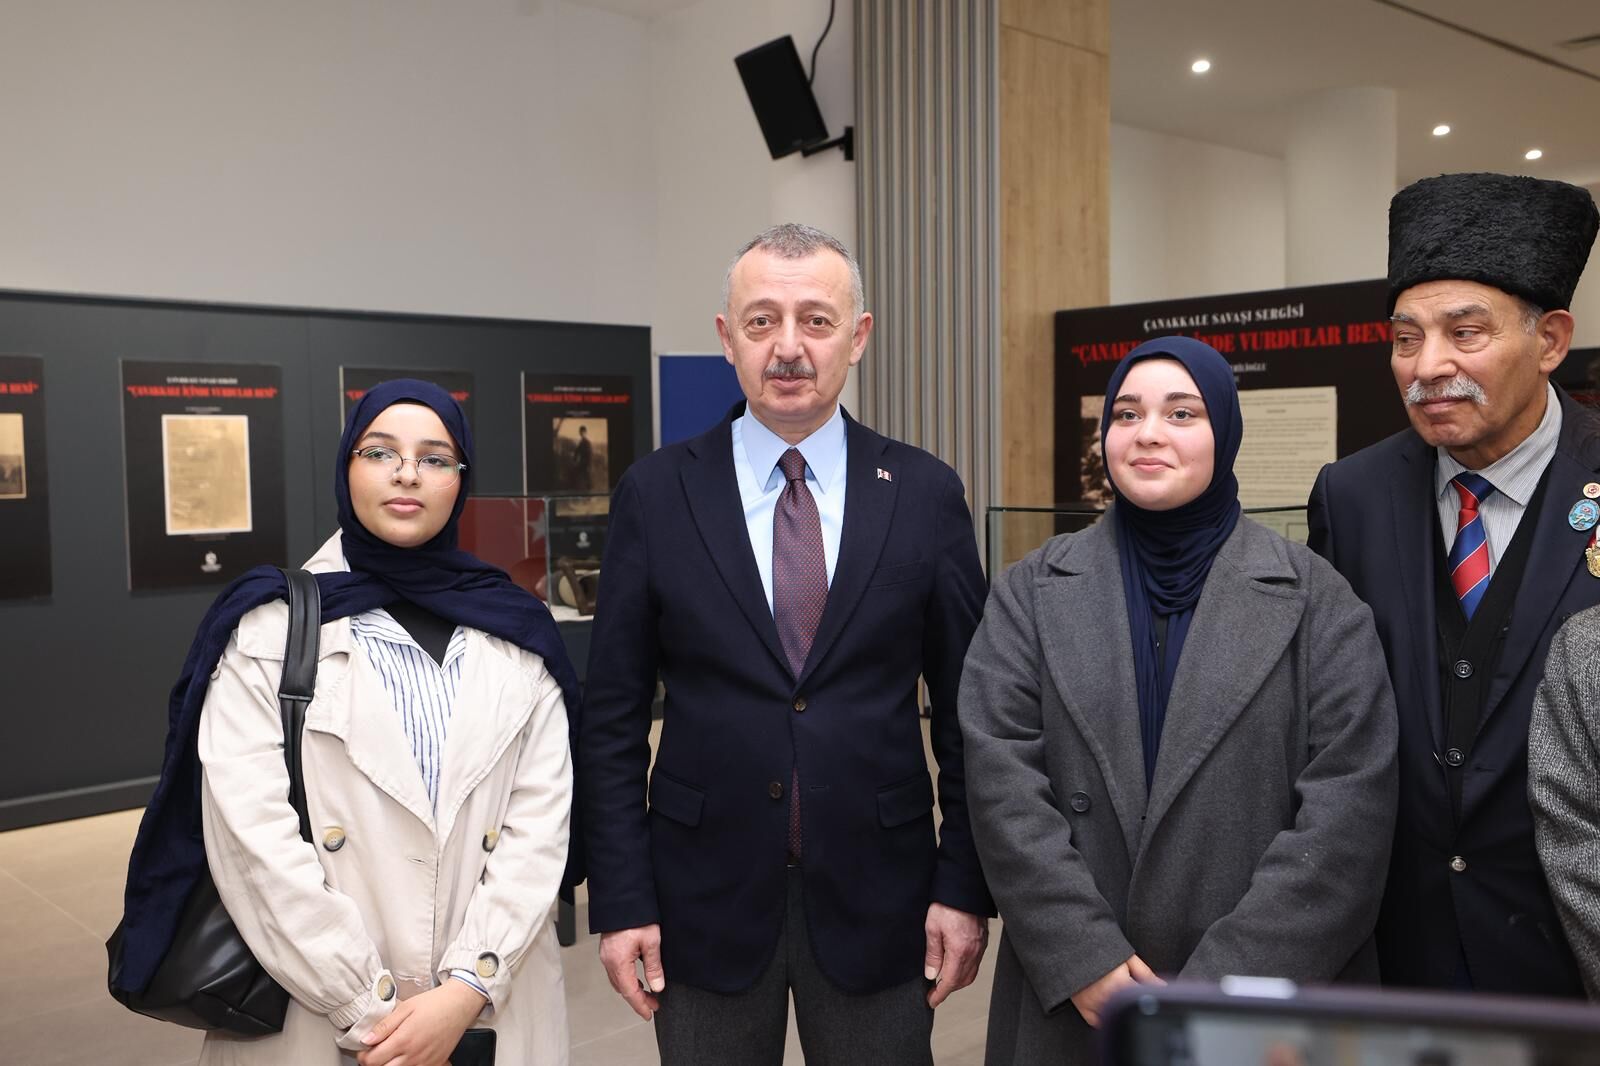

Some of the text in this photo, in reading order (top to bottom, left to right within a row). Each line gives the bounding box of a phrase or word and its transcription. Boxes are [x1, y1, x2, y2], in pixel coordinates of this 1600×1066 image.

[1143, 303, 1304, 332] ÇANAKKALE SAVAŞI SERGİSİ
[1239, 325, 1341, 352] VURDULAR
